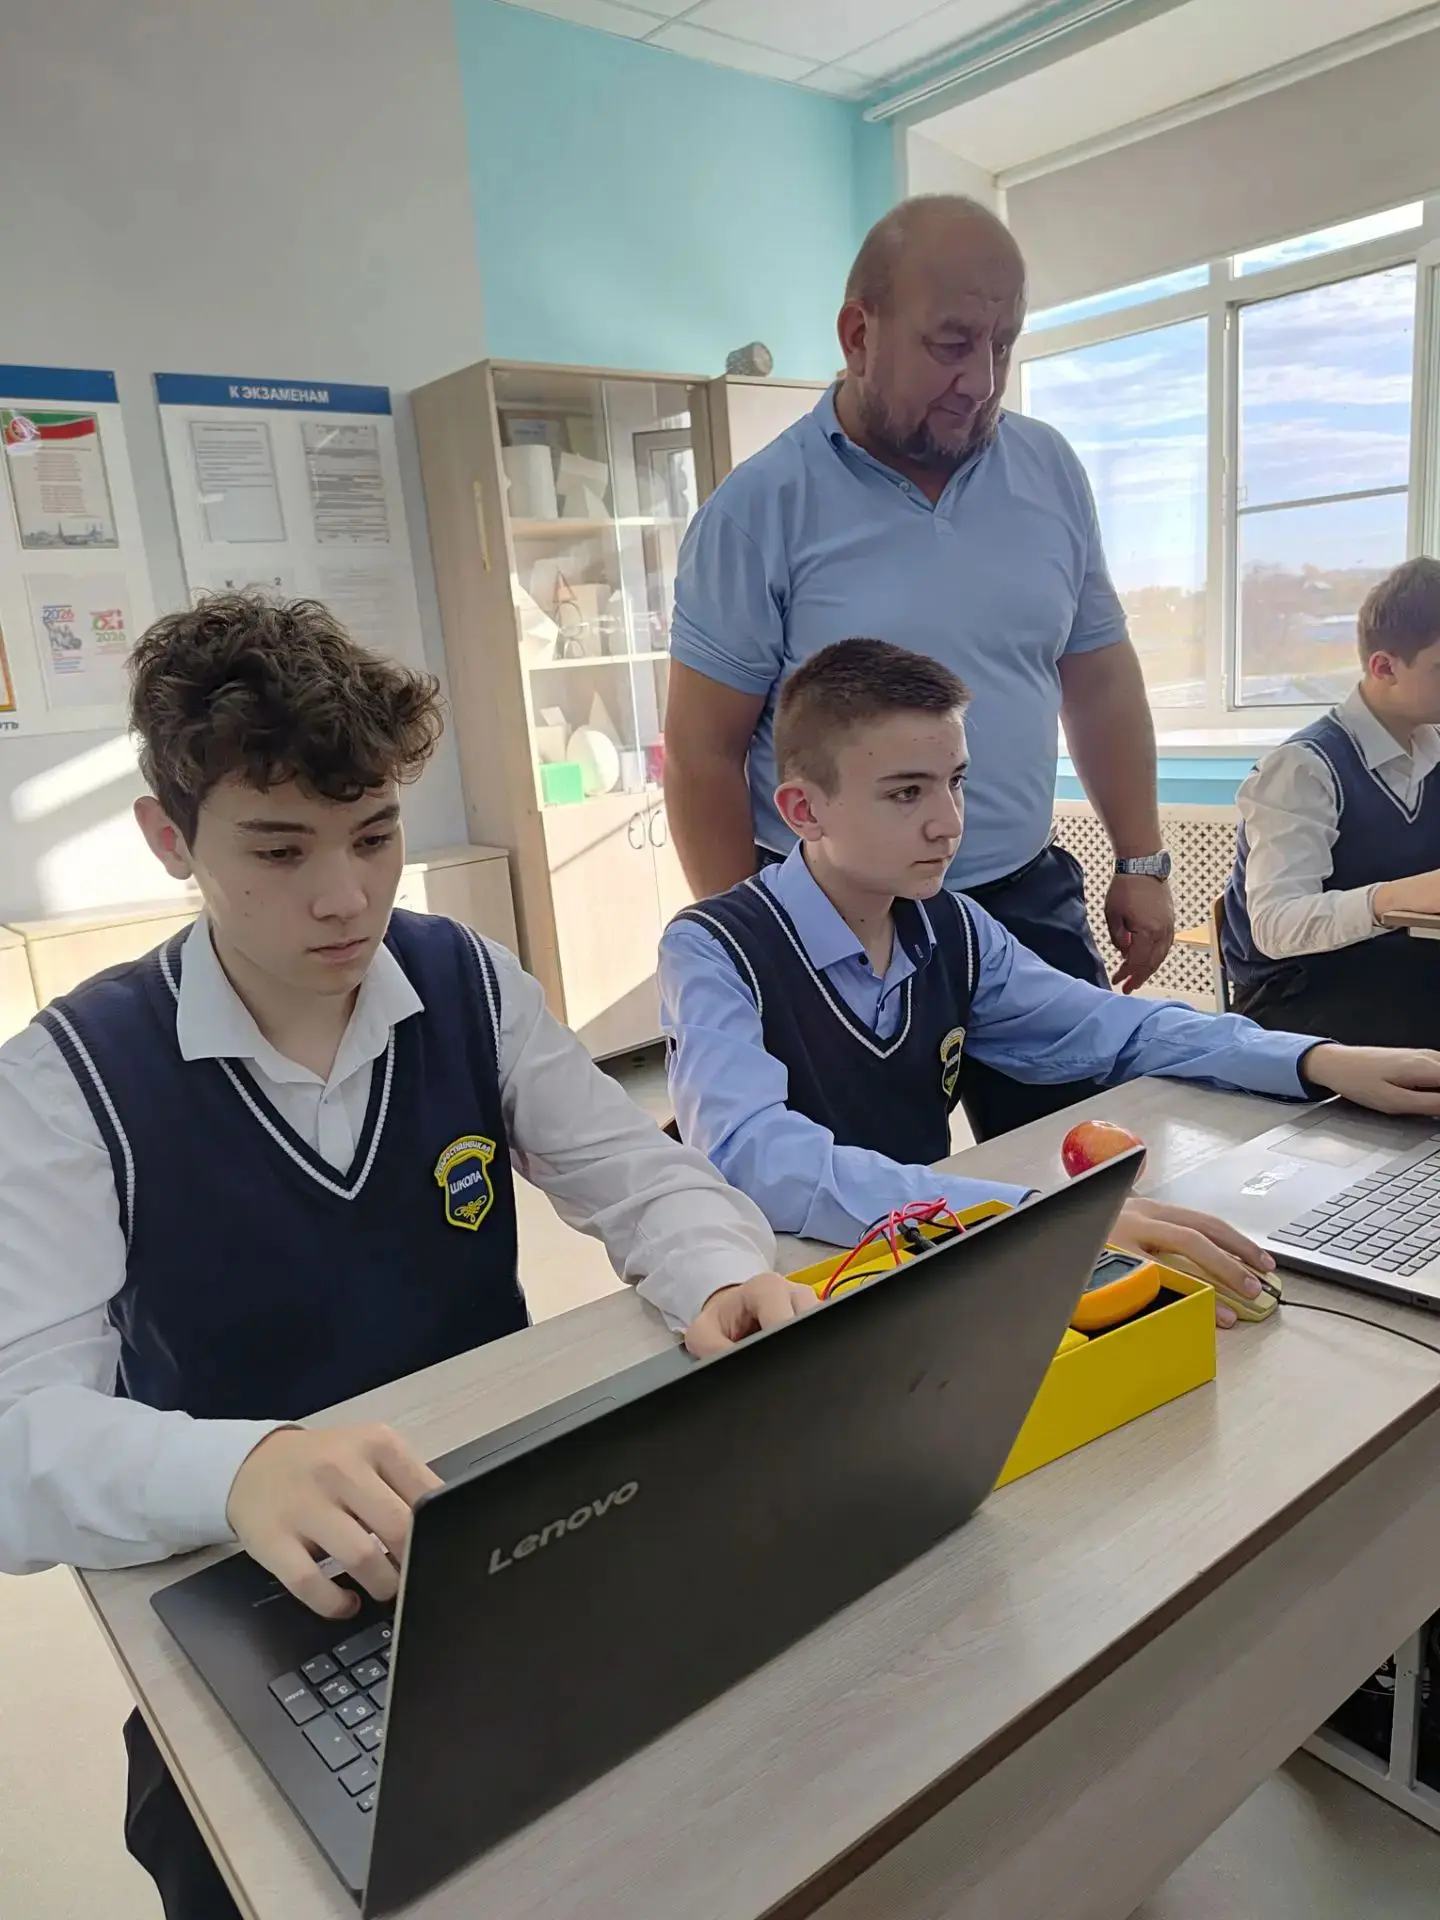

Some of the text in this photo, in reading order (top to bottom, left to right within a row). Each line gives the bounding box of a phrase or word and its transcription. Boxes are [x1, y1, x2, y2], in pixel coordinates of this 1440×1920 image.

[229, 385, 329, 403] К ЭКЗАМЕНАМ
[95, 632, 126, 643] 2026
[450, 1170, 483, 1195] ШКОЛА
[488, 1481, 639, 1576] Lenovo
[368, 1667, 381, 1677] 2
[284, 1688, 306, 1703] Enter
[337, 1684, 349, 1695] 3
[355, 1706, 367, 1716] 6
